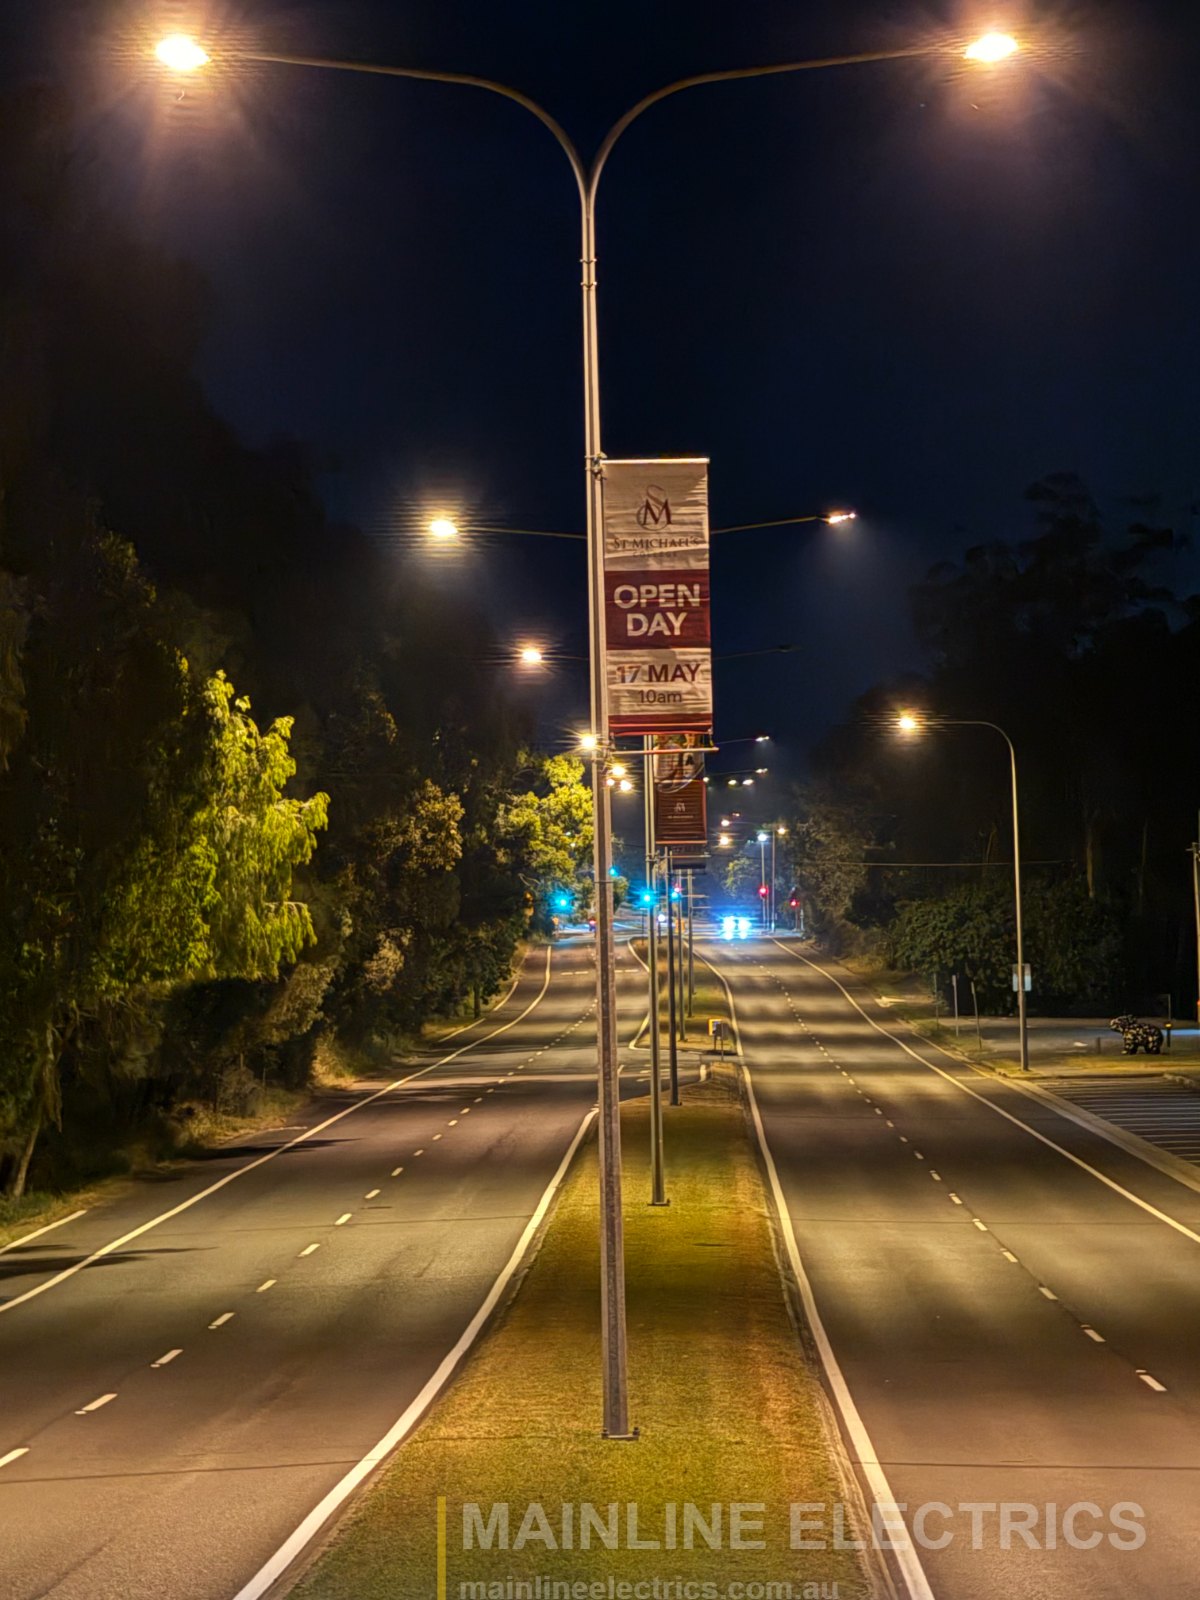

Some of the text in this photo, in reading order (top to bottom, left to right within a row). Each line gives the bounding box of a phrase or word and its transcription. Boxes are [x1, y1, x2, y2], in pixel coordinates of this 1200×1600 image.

[614, 584, 701, 609] OPEN
[626, 611, 687, 636] DAY
[616, 663, 701, 683] 17 MAY
[638, 690, 682, 703] 10am
